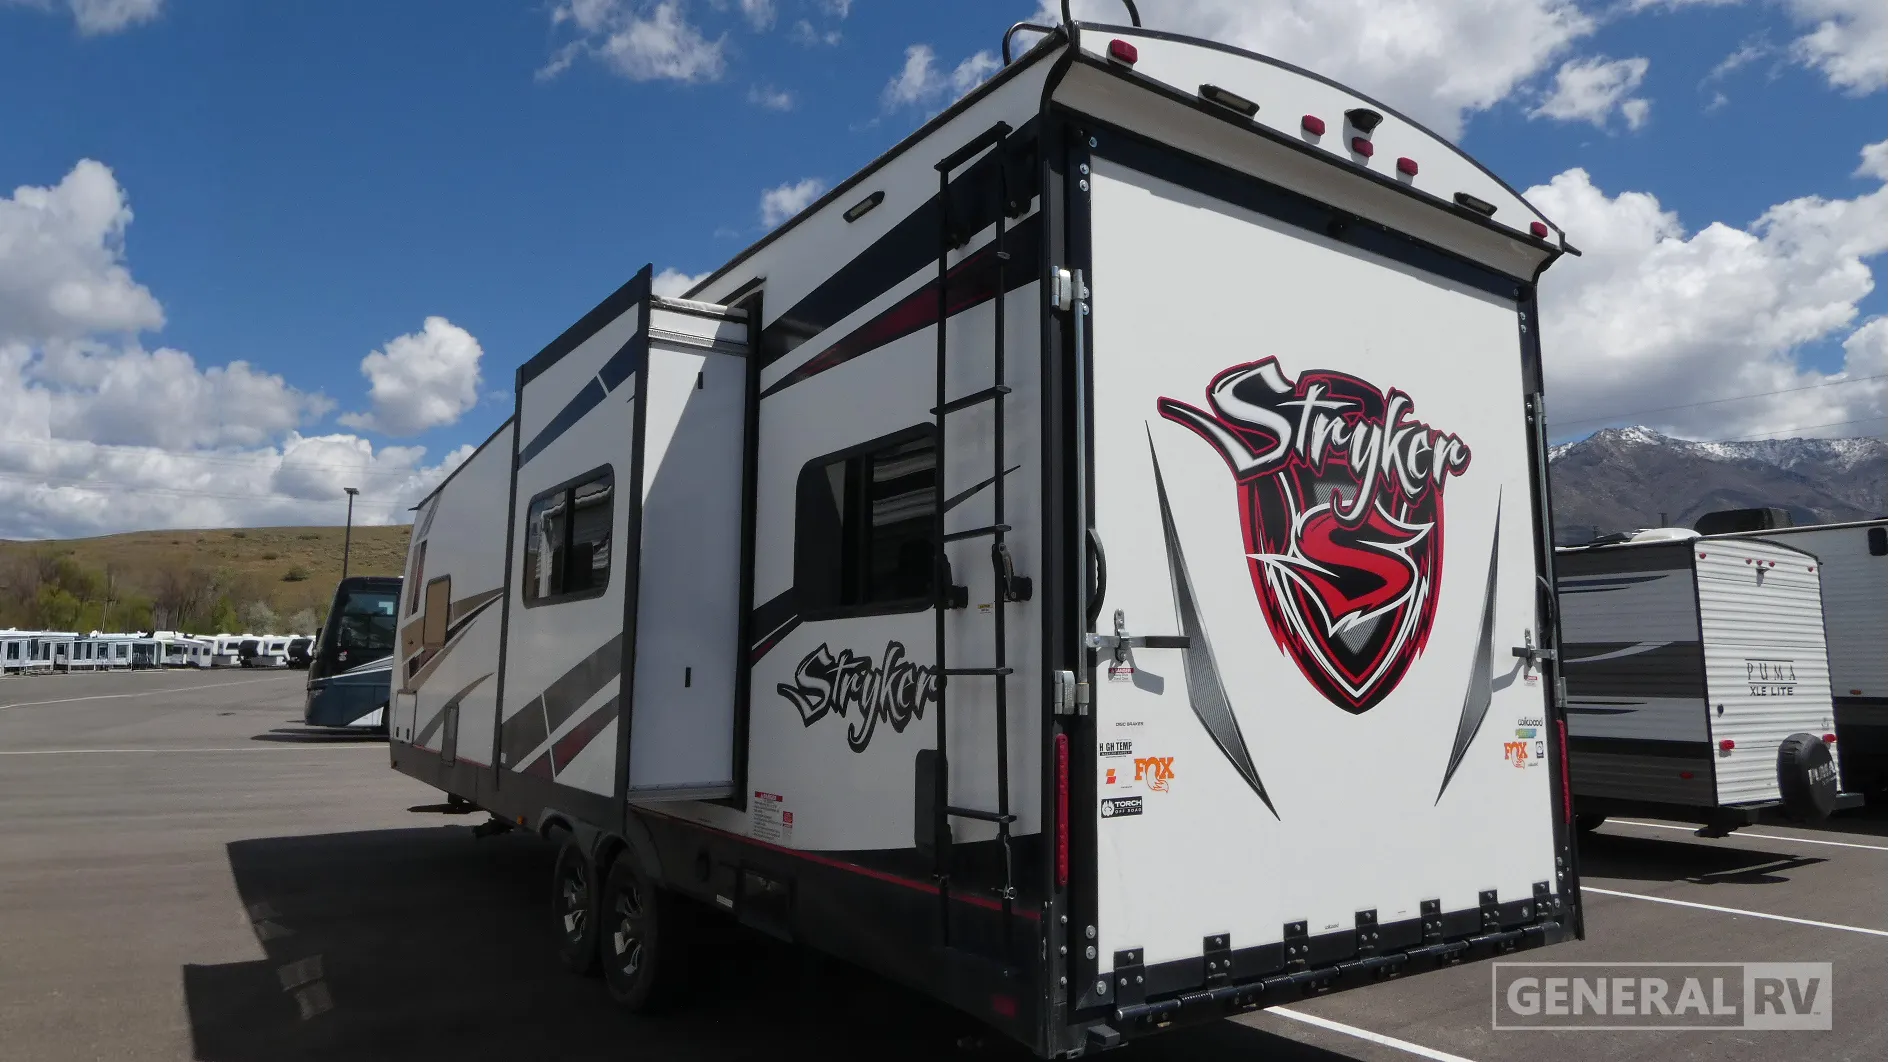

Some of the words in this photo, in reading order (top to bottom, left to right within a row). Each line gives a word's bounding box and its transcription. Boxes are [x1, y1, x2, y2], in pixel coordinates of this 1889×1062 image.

[1157, 355, 1472, 530] Stryker
[1746, 662, 1796, 681] PUMA
[777, 640, 943, 753] Stryker
[1750, 686, 1767, 696] XLE
[1770, 686, 1794, 696] LITE
[1099, 742, 1115, 752] HGH
[1116, 741, 1133, 751] TEMP
[1504, 741, 1528, 762] FOX
[1134, 757, 1175, 783] FOX
